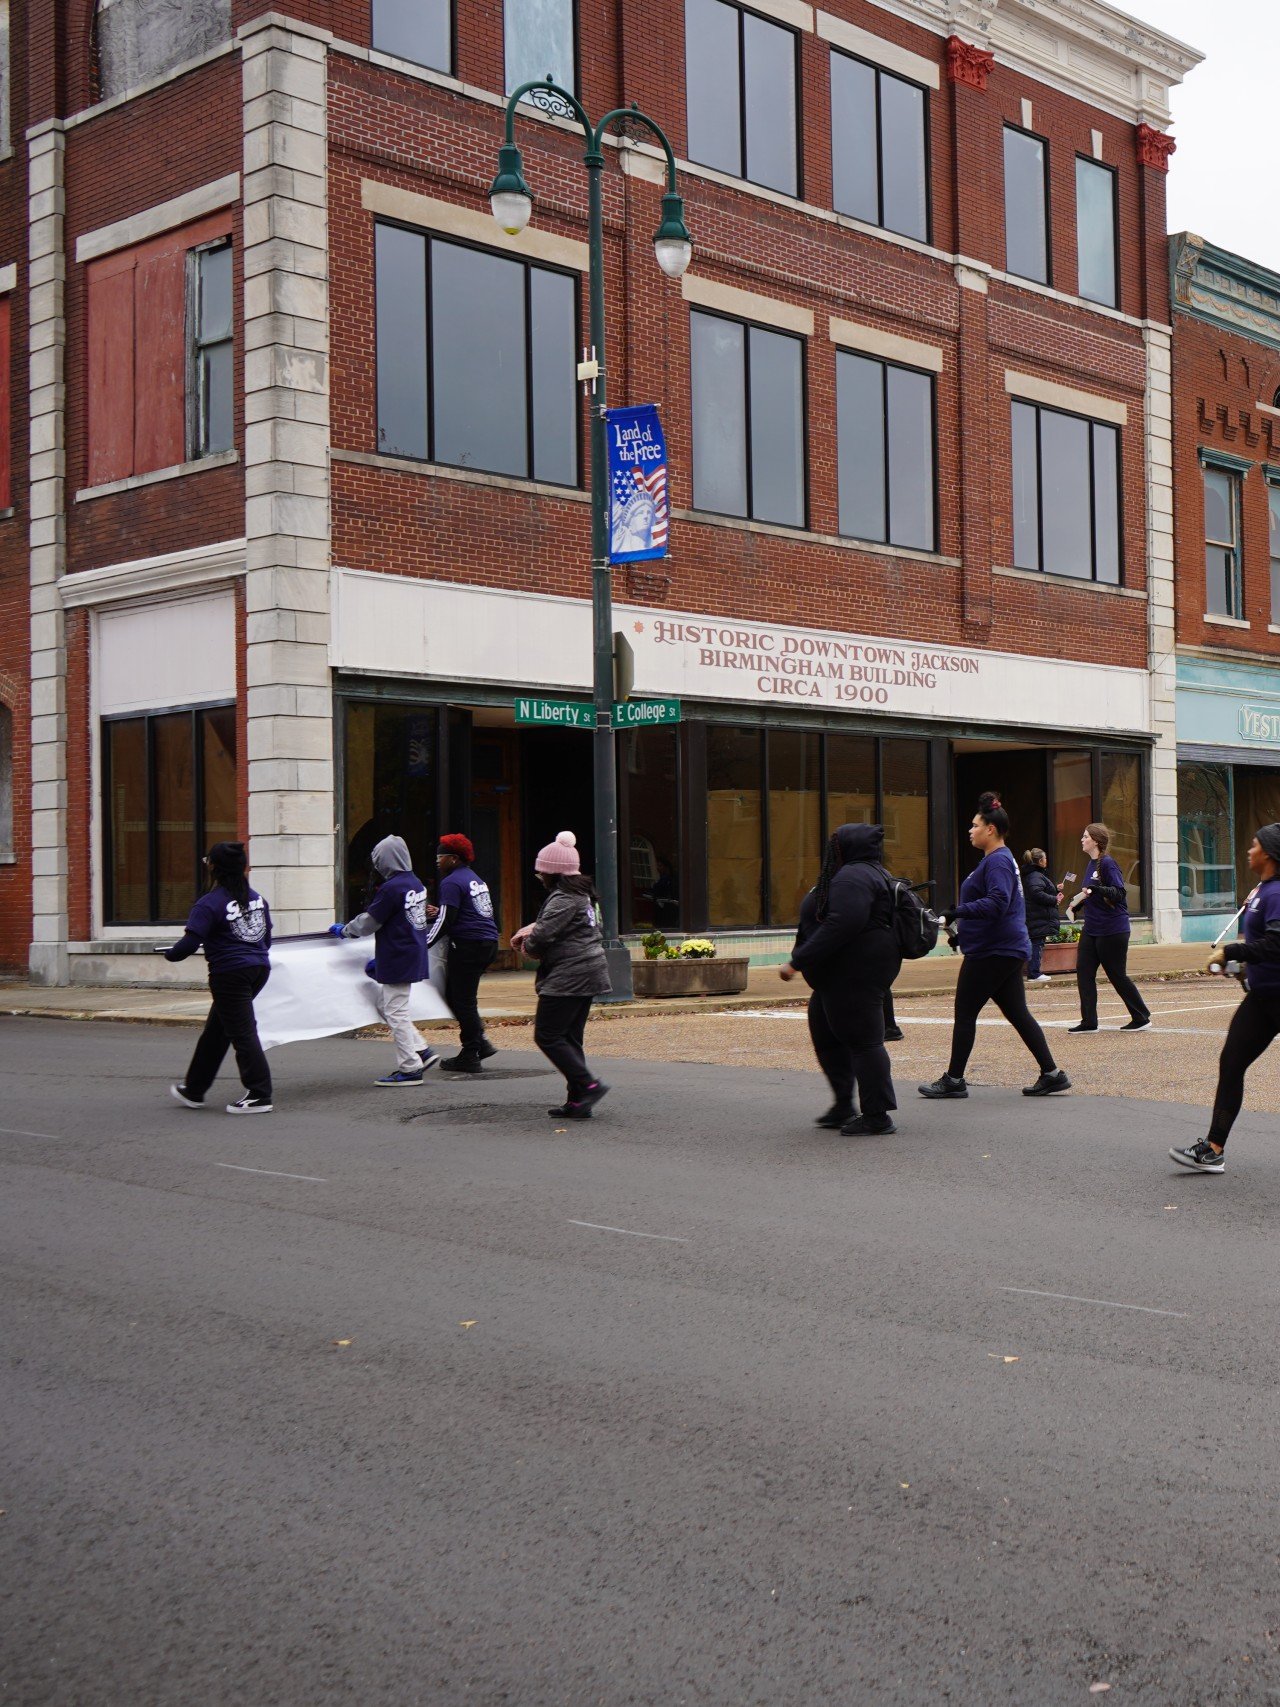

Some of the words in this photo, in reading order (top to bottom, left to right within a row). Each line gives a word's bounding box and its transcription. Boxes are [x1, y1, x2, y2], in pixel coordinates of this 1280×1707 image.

[614, 421, 641, 447] Land
[642, 424, 653, 441] of
[619, 447, 635, 461] the
[632, 441, 661, 464] Free
[654, 620, 775, 650] HISTORIC
[780, 636, 905, 666] DOWNTOWN
[911, 652, 979, 674] JACKSON
[699, 648, 844, 679] BIRMINGHAM
[850, 665, 937, 688] BUILDING
[757, 676, 823, 698] CIRCA
[834, 683, 889, 704] 1900
[520, 701, 529, 718] N
[533, 701, 579, 724] Liberty
[583, 713, 591, 722] St
[617, 705, 624, 722] E
[627, 703, 666, 723] College
[668, 707, 676, 717] St
